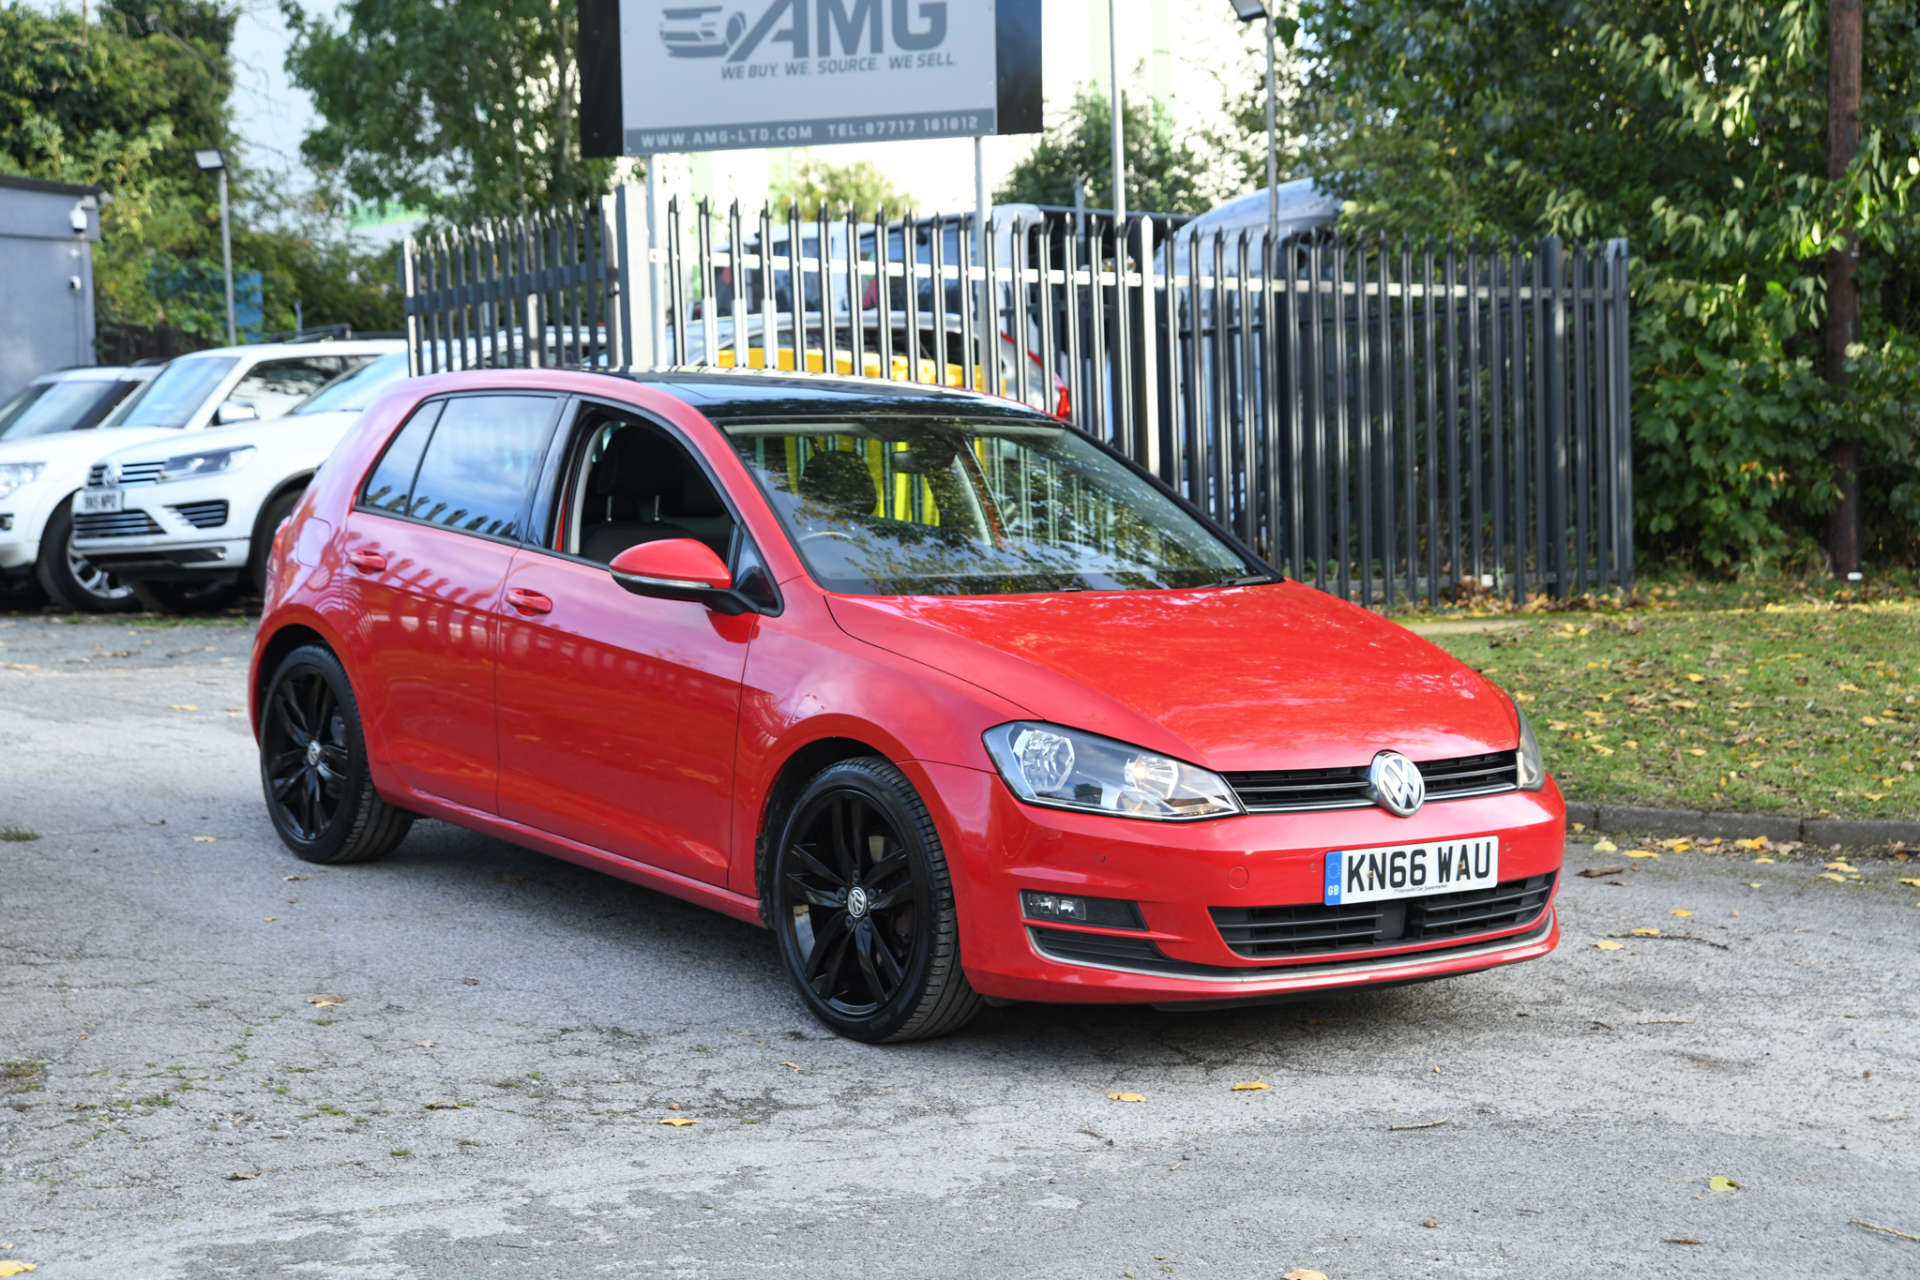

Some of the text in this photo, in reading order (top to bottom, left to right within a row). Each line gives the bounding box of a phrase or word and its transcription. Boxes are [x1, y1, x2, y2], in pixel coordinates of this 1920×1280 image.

[727, 0, 948, 62] AMG
[721, 65, 744, 80] WE
[889, 55, 912, 70] WE
[1347, 841, 1491, 893] KN66 WAU
[1328, 884, 1340, 896] GB
